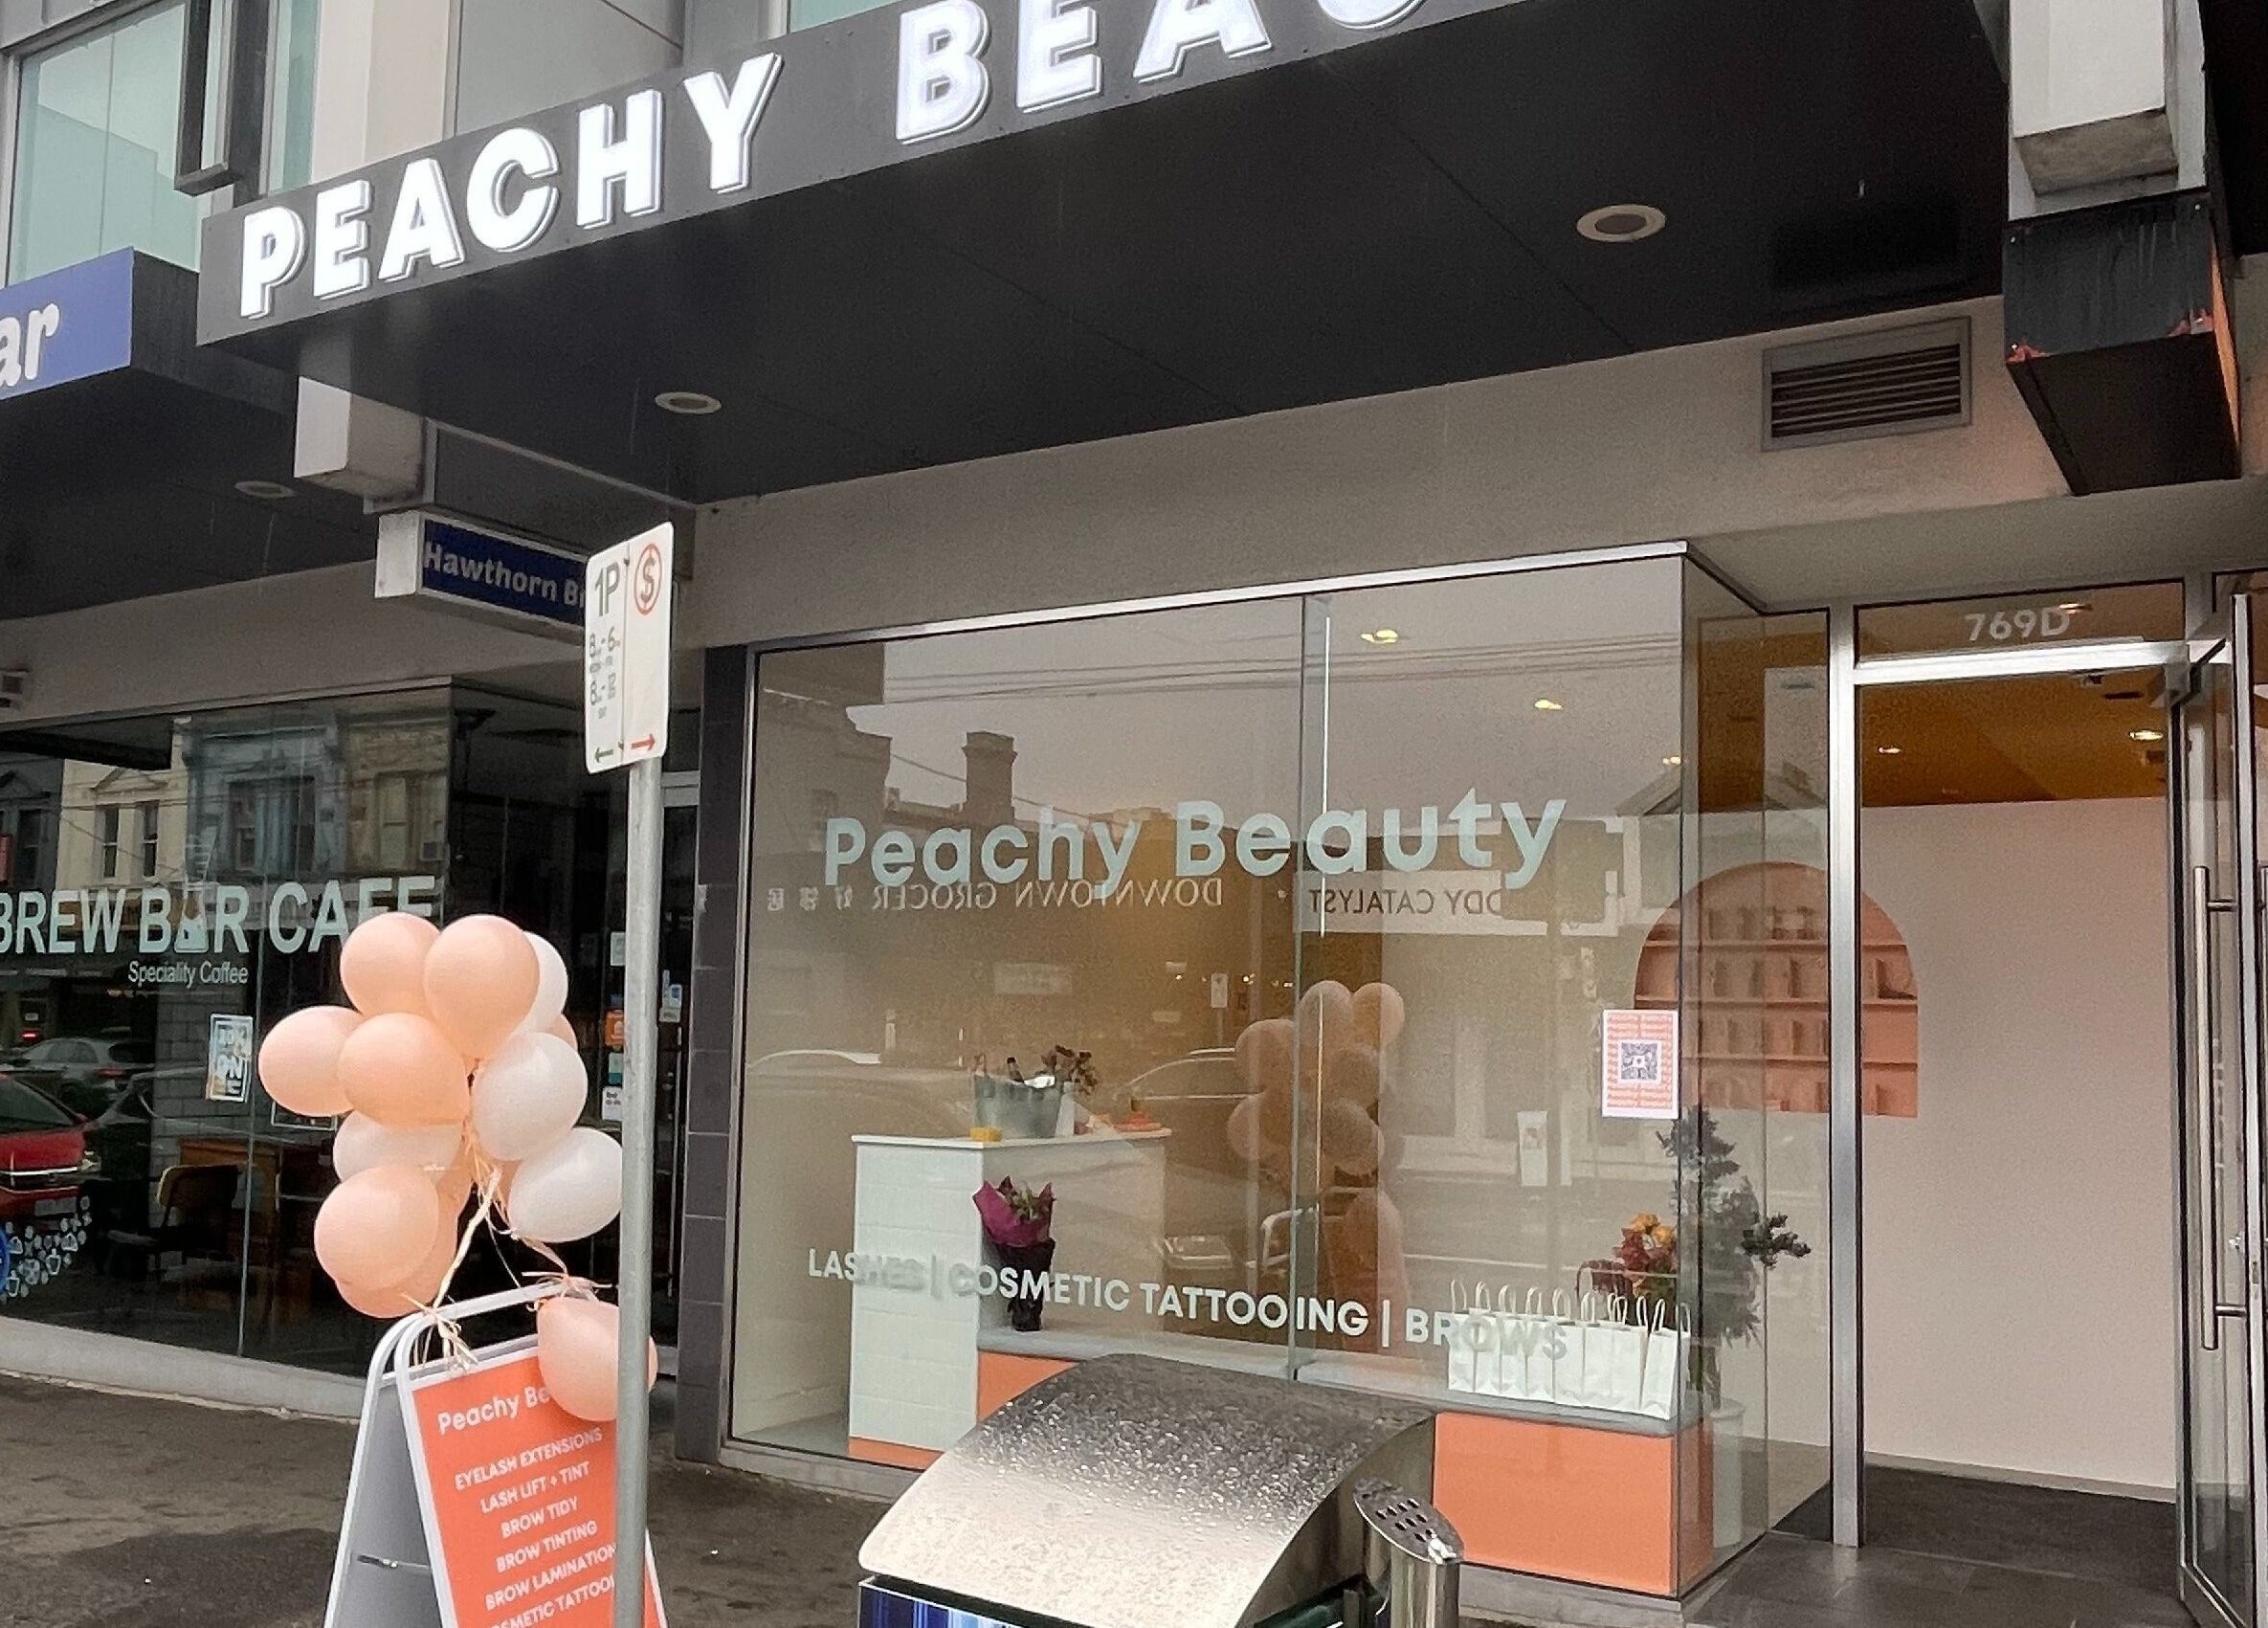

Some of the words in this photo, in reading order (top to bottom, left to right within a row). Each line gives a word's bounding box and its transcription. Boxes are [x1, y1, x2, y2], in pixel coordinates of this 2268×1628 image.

[240, 52, 782, 319] PEACHY
[896, 0, 1428, 144] BEA
[423, 542, 557, 602] Hawthorn
[595, 563, 620, 616] 1P
[1964, 607, 2071, 642] 769D
[824, 807, 1142, 900] Peachy
[1175, 787, 1567, 890] Beauty
[128, 961, 196, 989] Speciality
[199, 960, 249, 984] Coffee
[947, 1262, 1129, 1312] COSMETIC
[1140, 1282, 1369, 1337] TATTOOING
[1406, 1306, 1568, 1362] BROWS
[437, 1393, 520, 1435] Peachy
[455, 1456, 518, 1491] EYELASH
[520, 1426, 603, 1467] EXTENSIONS
[479, 1487, 518, 1513] LASH
[520, 1475, 546, 1500] LIFT
[559, 1461, 590, 1484] TINT
[500, 1509, 545, 1538] BROW
[547, 1496, 578, 1520] TIDY
[495, 1543, 541, 1572] BROW
[543, 1520, 598, 1552] TINTING
[484, 1577, 530, 1611] BROW
